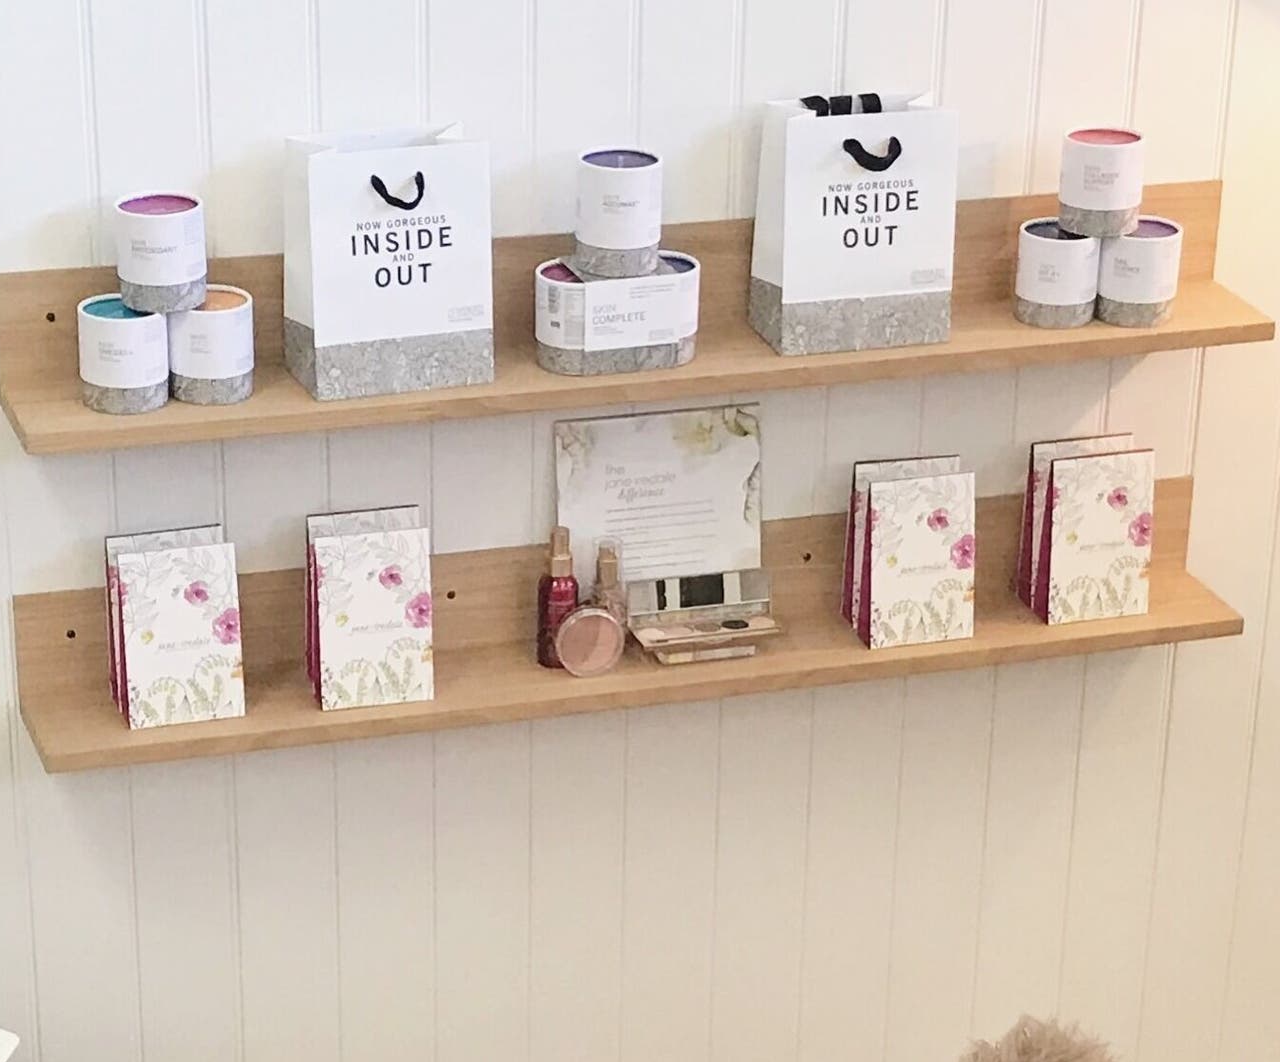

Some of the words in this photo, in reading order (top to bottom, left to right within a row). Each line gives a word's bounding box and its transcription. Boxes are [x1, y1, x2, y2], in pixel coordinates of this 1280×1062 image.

[828, 184, 853, 193] NOW
[857, 178, 915, 191] GORGEOUS
[822, 190, 919, 217] INSIDE
[356, 221, 382, 232] NOW
[386, 214, 446, 229] GORGEOUS
[860, 215, 882, 224] AND
[351, 225, 453, 257] INSIDE
[842, 225, 898, 249] OUT
[392, 252, 415, 263] AND
[374, 262, 433, 288] OUT
[592, 304, 616, 315] SKIN
[592, 311, 647, 326] COMPLETE
[605, 463, 626, 475] the
